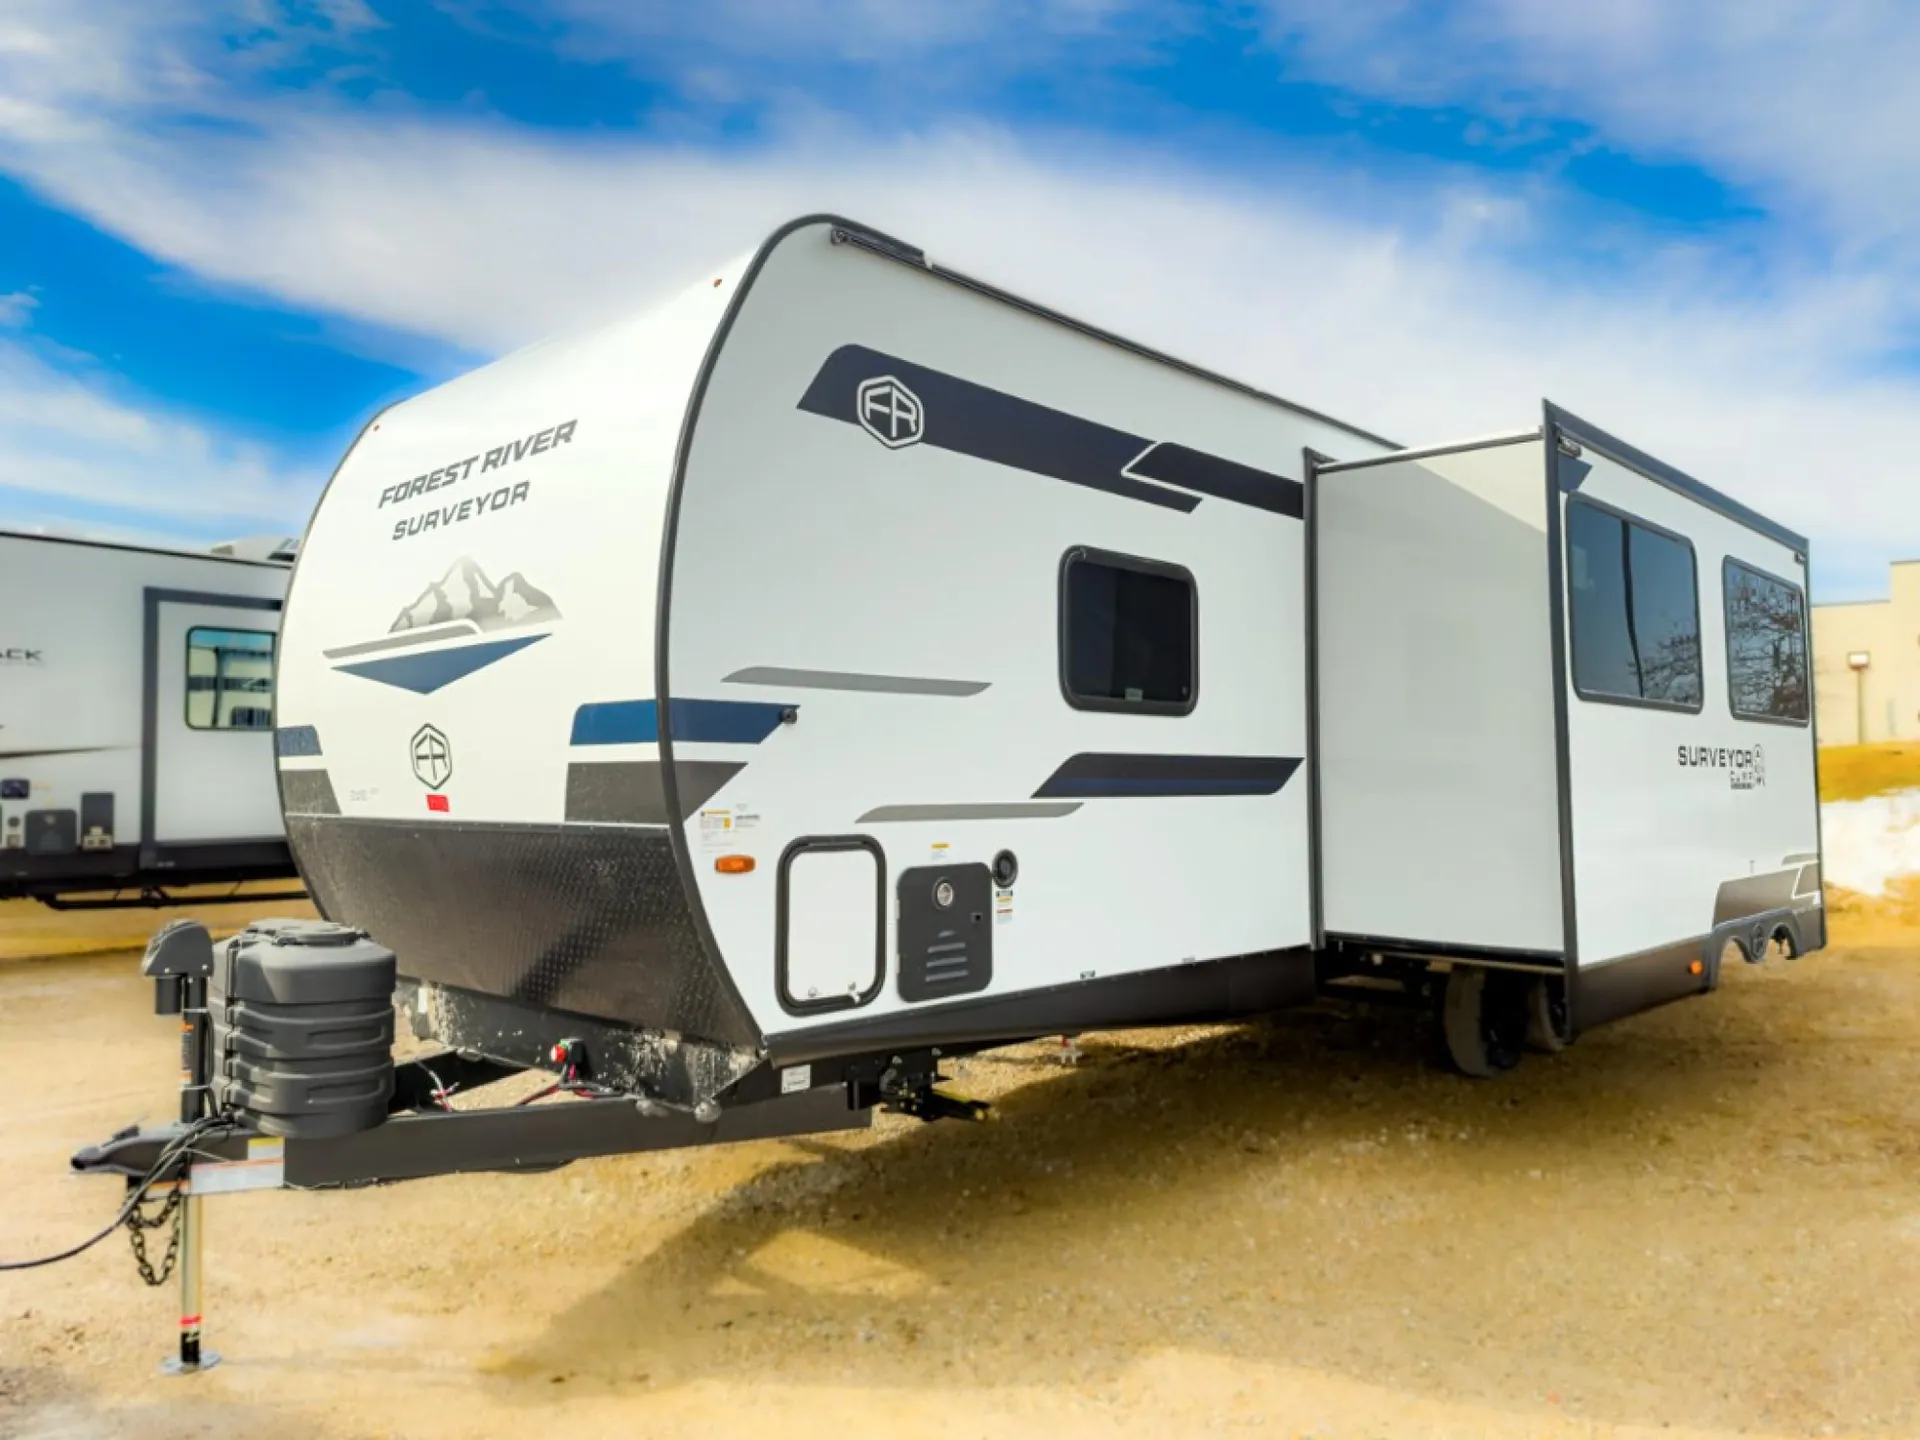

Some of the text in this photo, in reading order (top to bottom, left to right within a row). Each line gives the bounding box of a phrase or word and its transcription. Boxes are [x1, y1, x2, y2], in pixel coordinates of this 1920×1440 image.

[377, 418, 578, 509] FOREST RIVER
[391, 479, 531, 541] SURVEYOR
[1677, 745, 1753, 768] SURVEYOR
